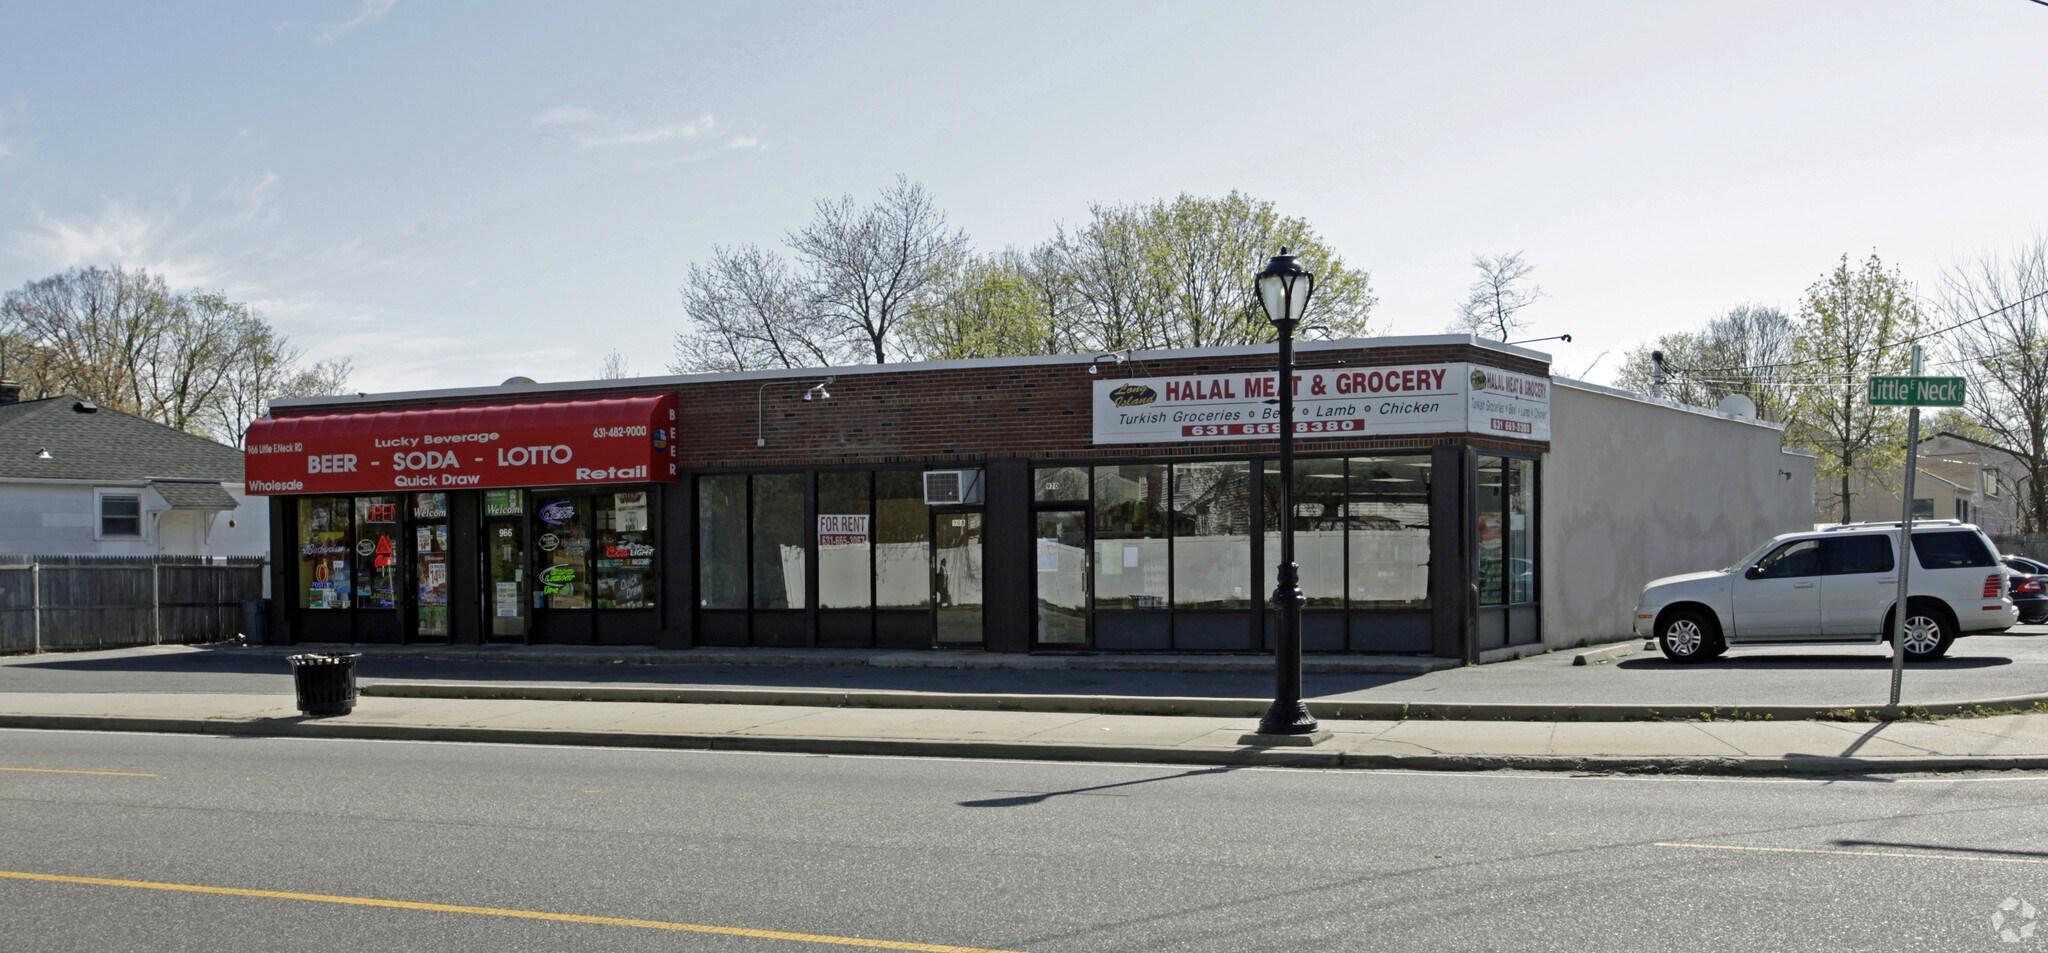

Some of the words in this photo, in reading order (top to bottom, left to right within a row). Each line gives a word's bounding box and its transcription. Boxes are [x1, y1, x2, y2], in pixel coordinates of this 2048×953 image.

[1114, 383, 1148, 395] Long
[1166, 379, 1235, 401] HALAL
[1245, 376, 1302, 398] MET
[1311, 374, 1327, 396] &
[1336, 368, 1446, 394] GROCERY
[1487, 373, 1504, 391] HALAL
[1506, 376, 1518, 393] MEAT
[1525, 380, 1546, 399] GROCERY
[1870, 379, 1908, 400] Little
[1910, 380, 1914, 390] E
[1917, 380, 1957, 400] Neck
[1115, 393, 1157, 407] Island
[1119, 411, 1167, 425] Turkish
[1173, 409, 1240, 423] Groceries
[1262, 407, 1295, 419] Be
[1316, 404, 1356, 417] Lamb
[1379, 401, 1439, 415] Chicken
[1192, 425, 1229, 435] 631
[1243, 424, 1280, 434] 669
[1296, 421, 1354, 432] 8380
[1493, 420, 1503, 429] 631
[593, 426, 647, 438] 631-482-9000
[375, 437, 419, 447] Lucky
[424, 432, 500, 444] Beverage
[248, 445, 258, 454] 966
[260, 444, 272, 454] Little
[295, 443, 303, 452] RD
[308, 454, 357, 474] BEER
[393, 450, 460, 471] SODA
[498, 444, 572, 466] LOTTO
[576, 465, 647, 480] Retail
[249, 479, 303, 491] Wholesale
[395, 474, 437, 487] Quick
[442, 474, 480, 485] Draw
[414, 507, 446, 518] Welcom
[487, 503, 522, 515] Welcom
[821, 516, 838, 531] FOR
[842, 516, 865, 531] RENT
[499, 529, 512, 537] 966
[621, 574, 637, 590] Quick
[626, 583, 642, 599] Draw
